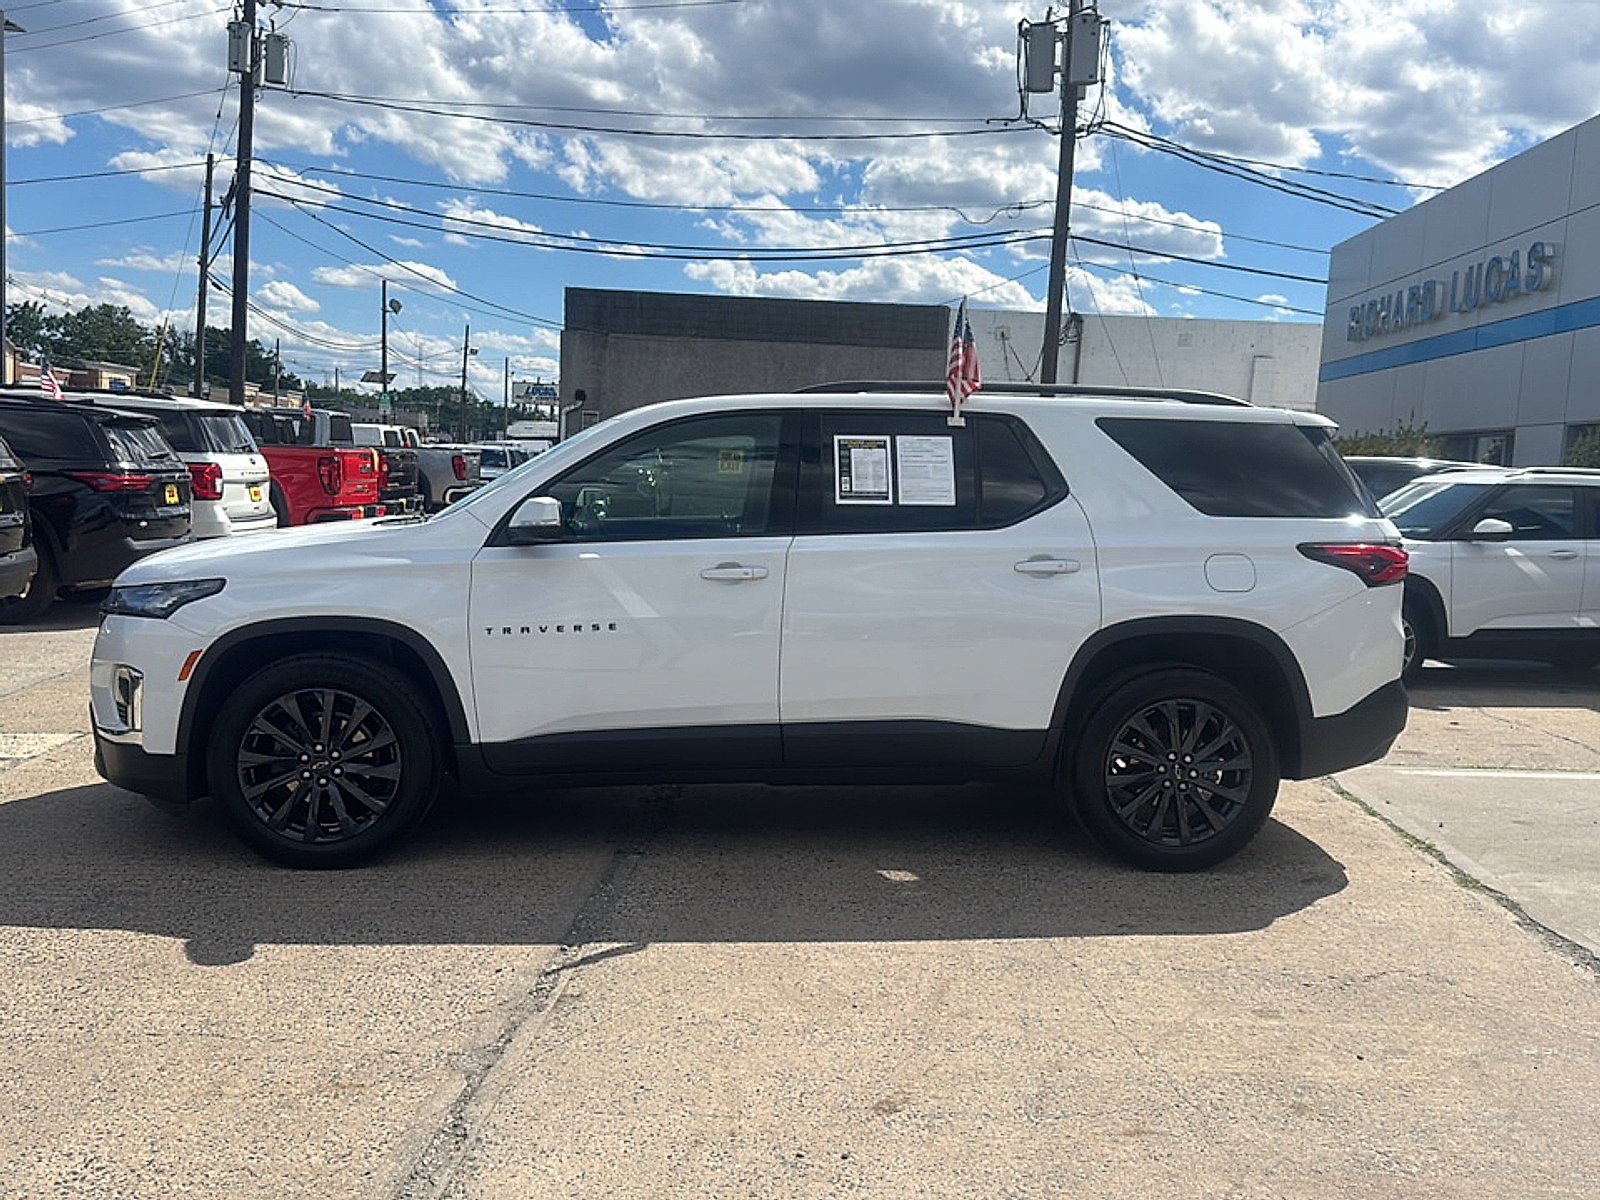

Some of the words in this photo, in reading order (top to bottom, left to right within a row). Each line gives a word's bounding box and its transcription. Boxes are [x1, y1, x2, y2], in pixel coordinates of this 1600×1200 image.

[1346, 280, 1440, 342] RICHARD
[1449, 241, 1551, 313] LUCAS
[485, 623, 617, 635] TRAVERSE
